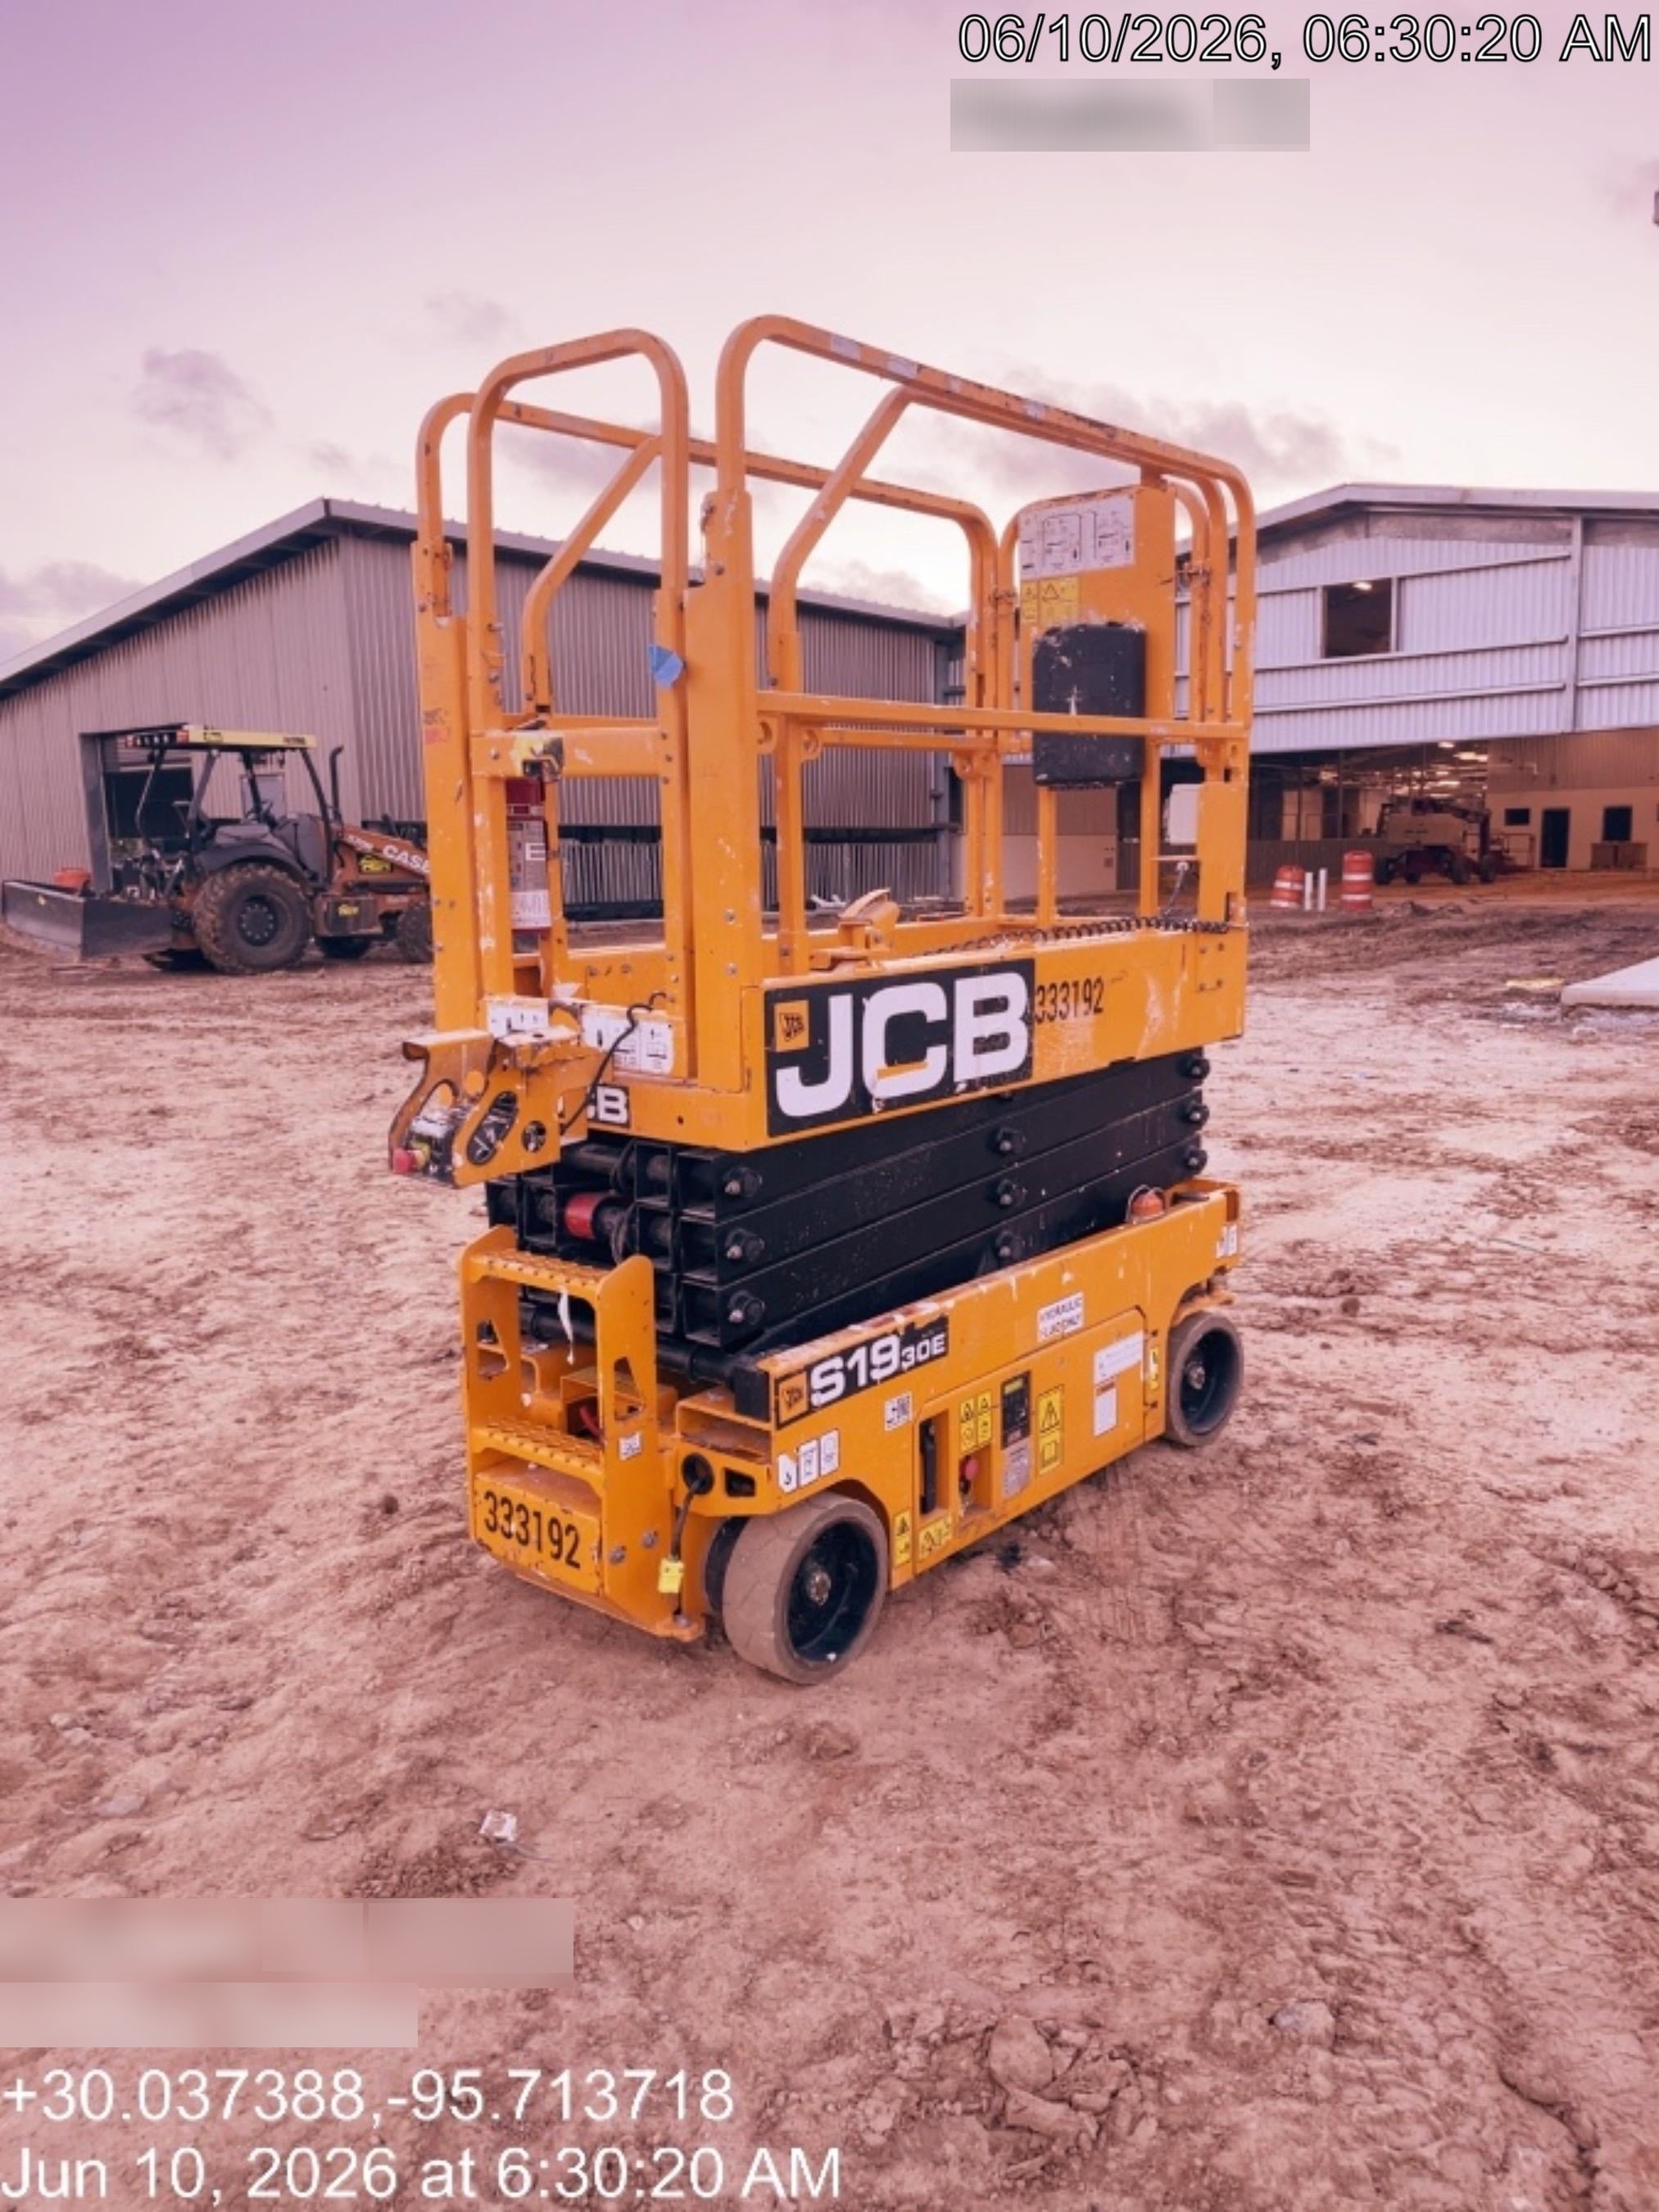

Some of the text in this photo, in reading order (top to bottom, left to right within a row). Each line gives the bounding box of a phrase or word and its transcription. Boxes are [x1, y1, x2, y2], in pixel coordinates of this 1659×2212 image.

[1034, 977, 1105, 1025] 333192
[776, 972, 1028, 1117] JCB
[483, 1490, 581, 1570] 333192
